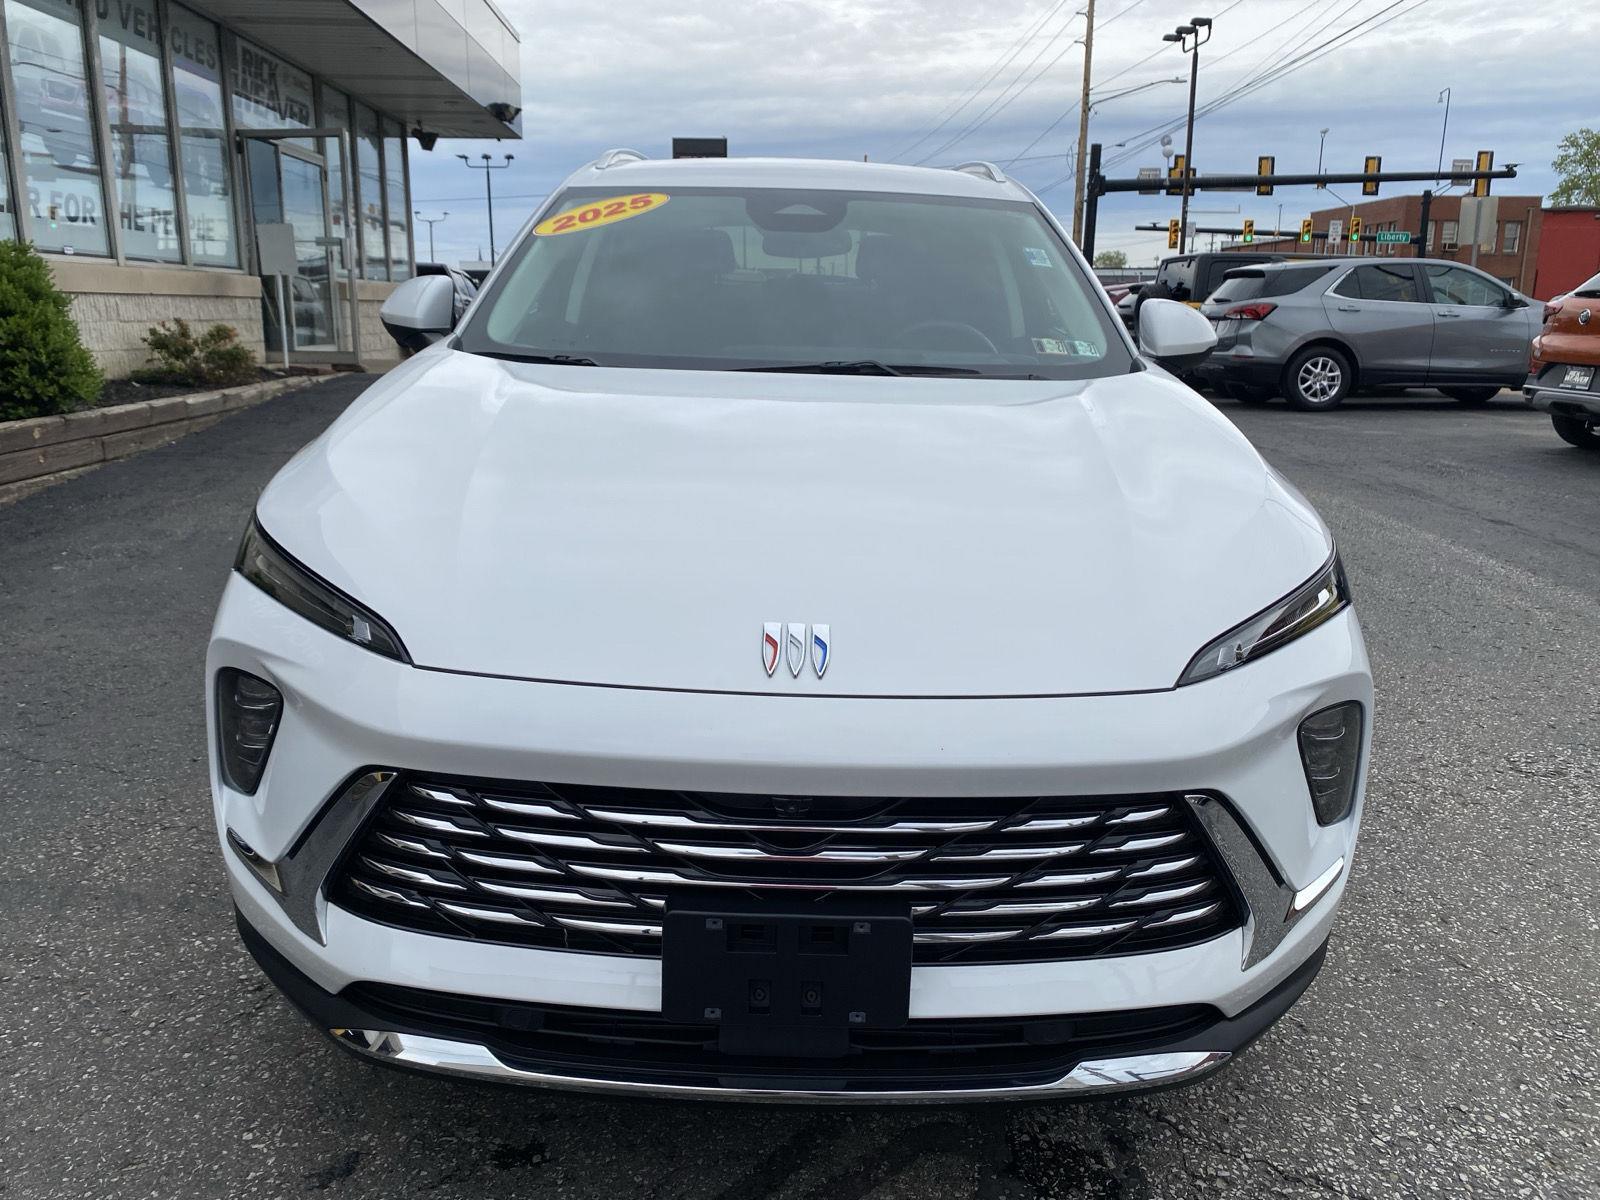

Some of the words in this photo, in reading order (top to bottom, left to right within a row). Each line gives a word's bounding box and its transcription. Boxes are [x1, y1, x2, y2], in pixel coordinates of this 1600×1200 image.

[117, 0, 216, 70] VEHCLES
[50, 190, 97, 226] FOR
[120, 201, 146, 232] HE
[552, 195, 653, 232] 2025
[1380, 233, 1407, 241] Liberty
